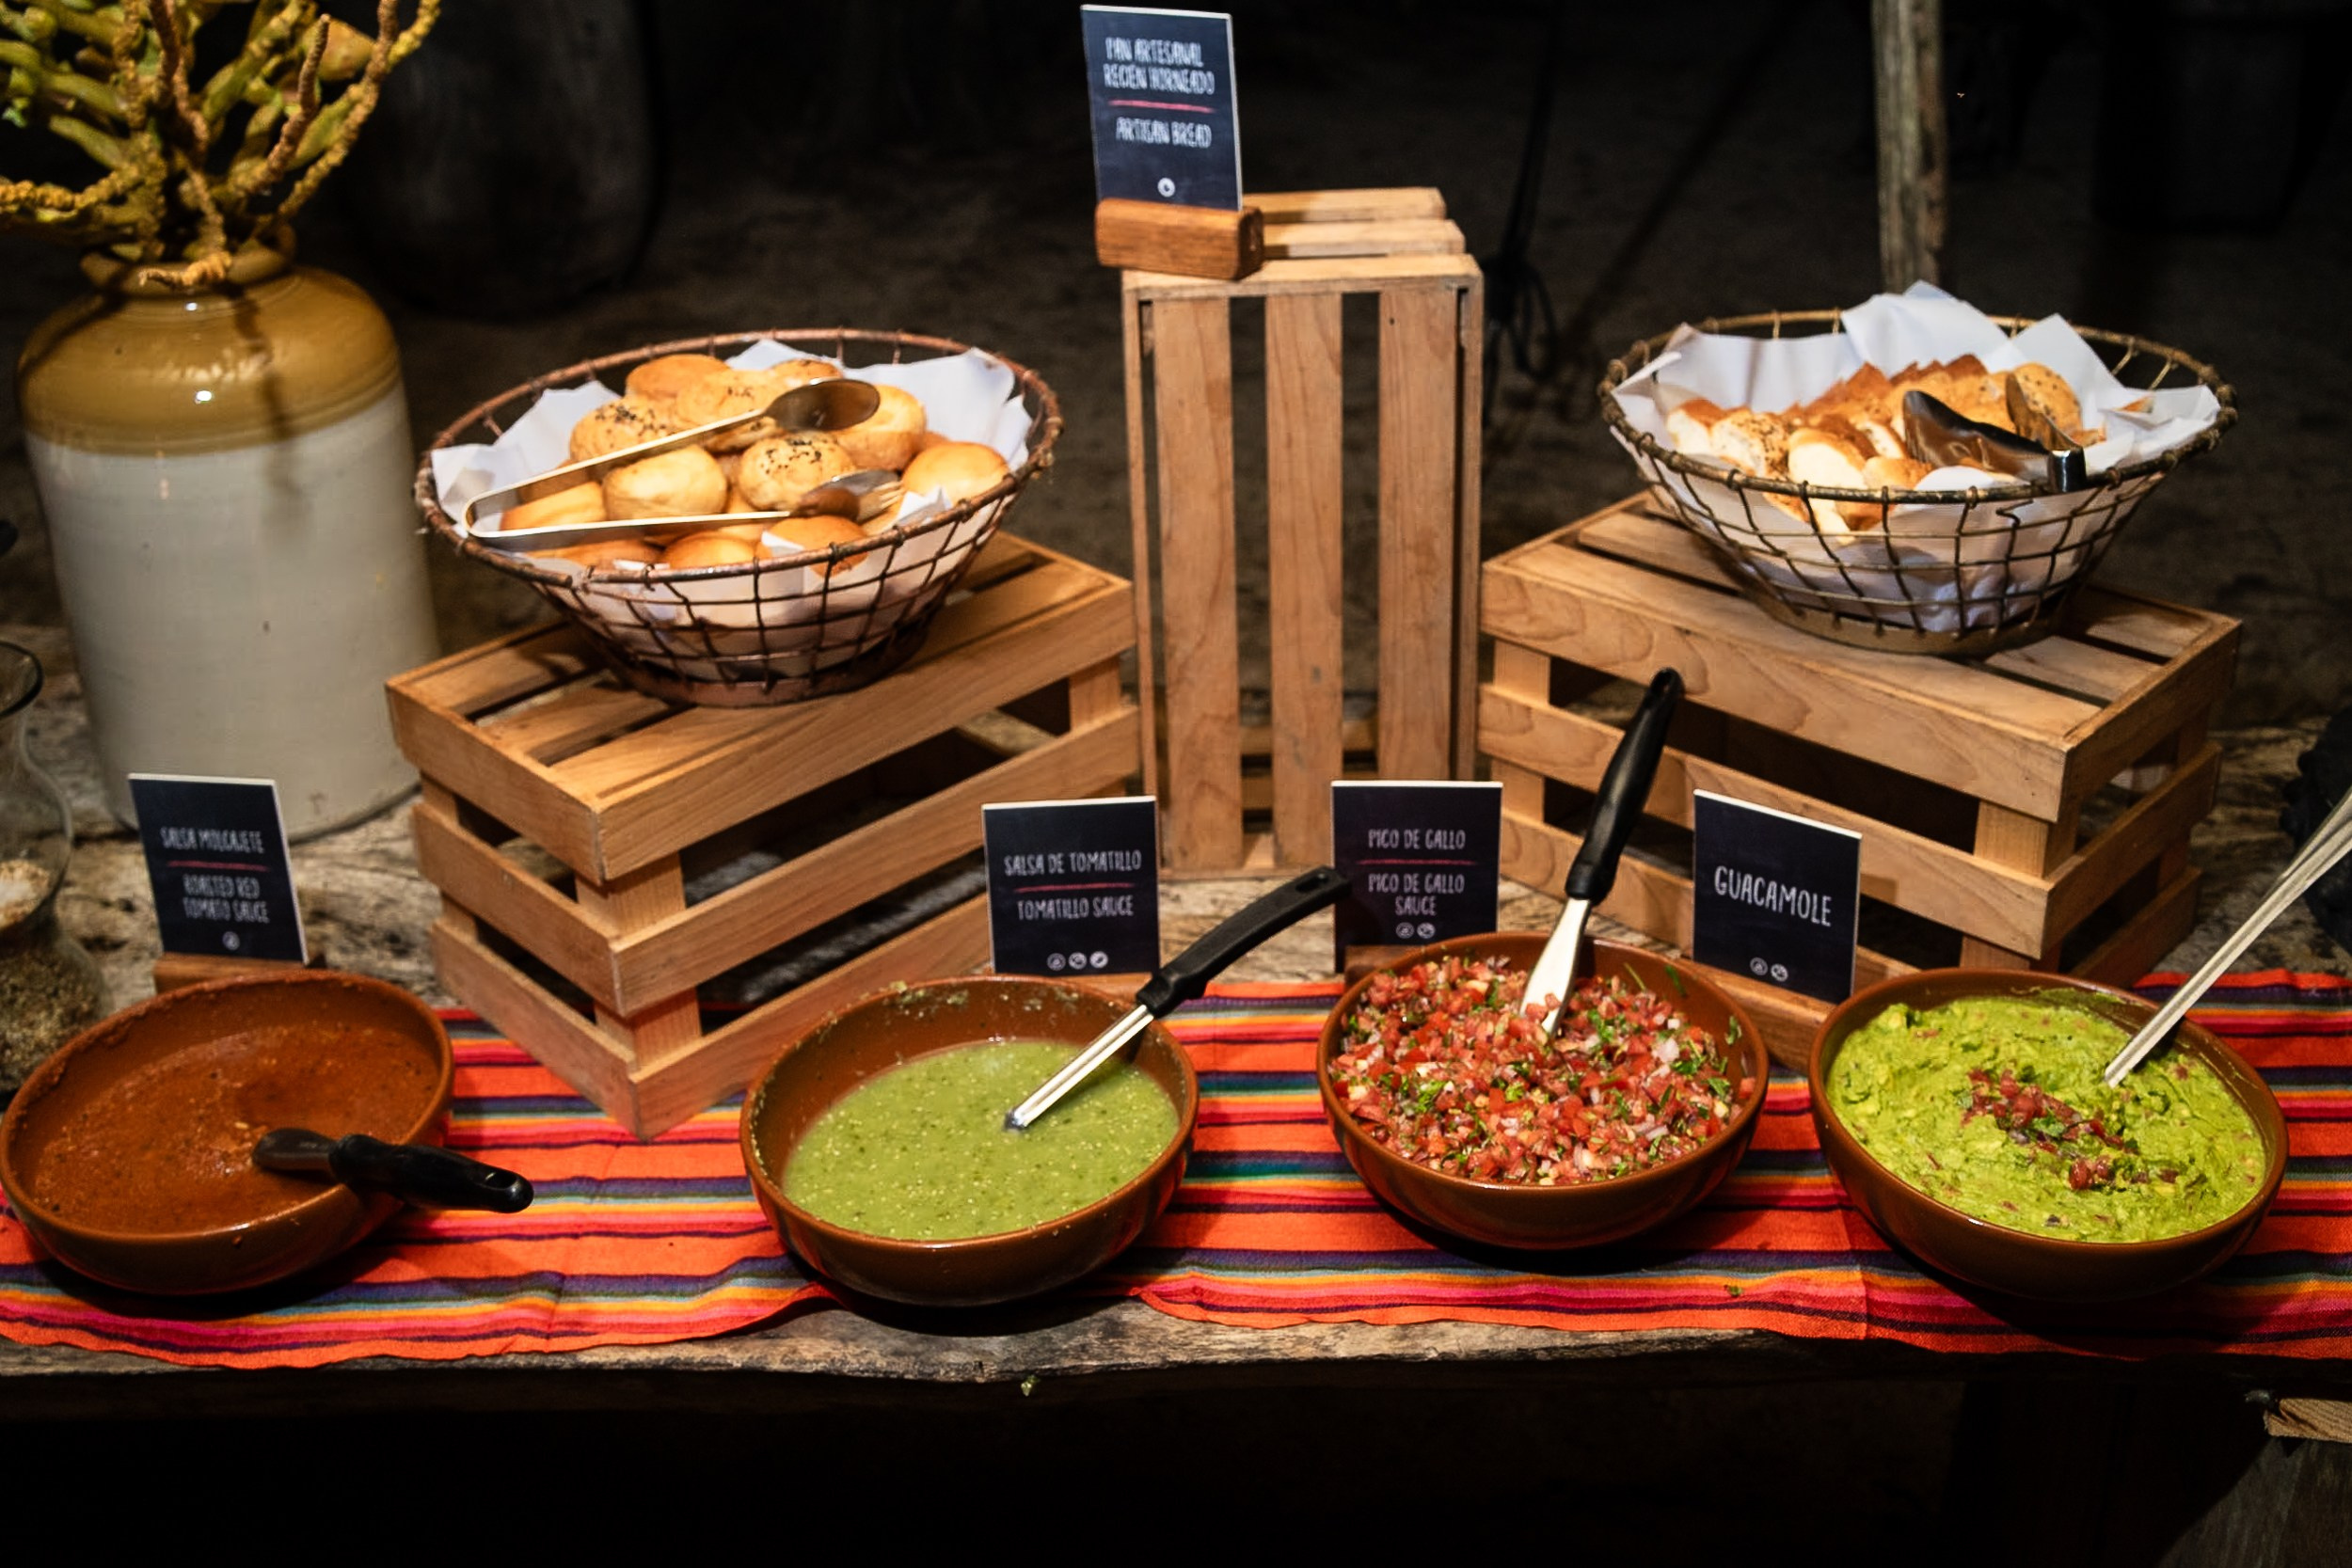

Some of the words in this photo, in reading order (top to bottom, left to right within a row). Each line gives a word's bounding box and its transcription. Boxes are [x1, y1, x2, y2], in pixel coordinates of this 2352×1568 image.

[1105, 37, 1132, 61] PAN
[1135, 39, 1203, 68] ARTESANAL
[1149, 67, 1215, 94] HORNEADO
[1116, 117, 1170, 144] ARTISAN
[1171, 121, 1212, 149] BREAD
[160, 827, 198, 849] SALSA
[1368, 829, 1399, 848] PICO
[1404, 829, 1421, 849] DE
[1425, 829, 1466, 850] GALLO
[1004, 854, 1044, 877] SALSA
[1047, 852, 1065, 874] DE
[1069, 849, 1142, 873] TOMATILLO
[235, 877, 260, 899] RED
[1368, 873, 1399, 893] PICO
[1403, 873, 1420, 894] DE
[1424, 873, 1465, 894] GALLO
[1714, 865, 1831, 927] GUACAMOLE
[183, 897, 231, 921] TOMATO
[232, 900, 270, 924] SAUCE
[1017, 897, 1089, 920] TOMATILLO
[1092, 895, 1134, 918] SAUCE
[1395, 895, 1437, 916] SAUCE
